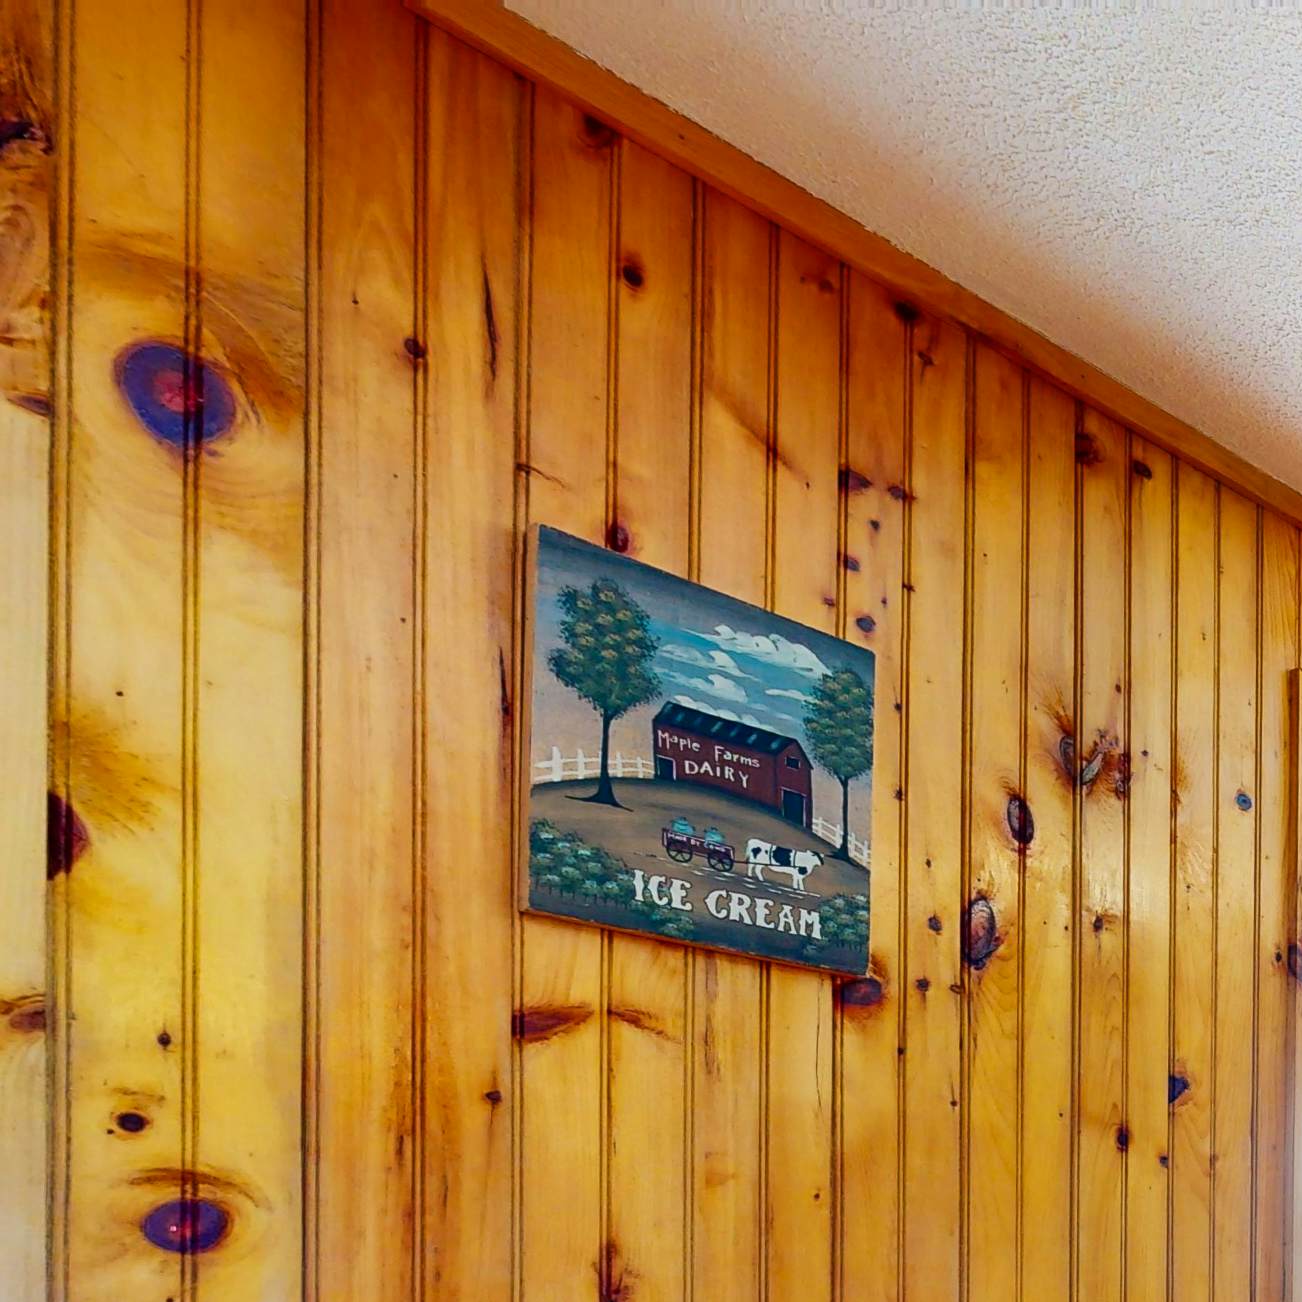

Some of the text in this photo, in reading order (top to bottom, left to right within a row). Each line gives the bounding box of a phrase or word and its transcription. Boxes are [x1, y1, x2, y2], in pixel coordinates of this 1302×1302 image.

[657, 729, 761, 768] Maple Farms
[632, 868, 822, 940] ICE CREAM
